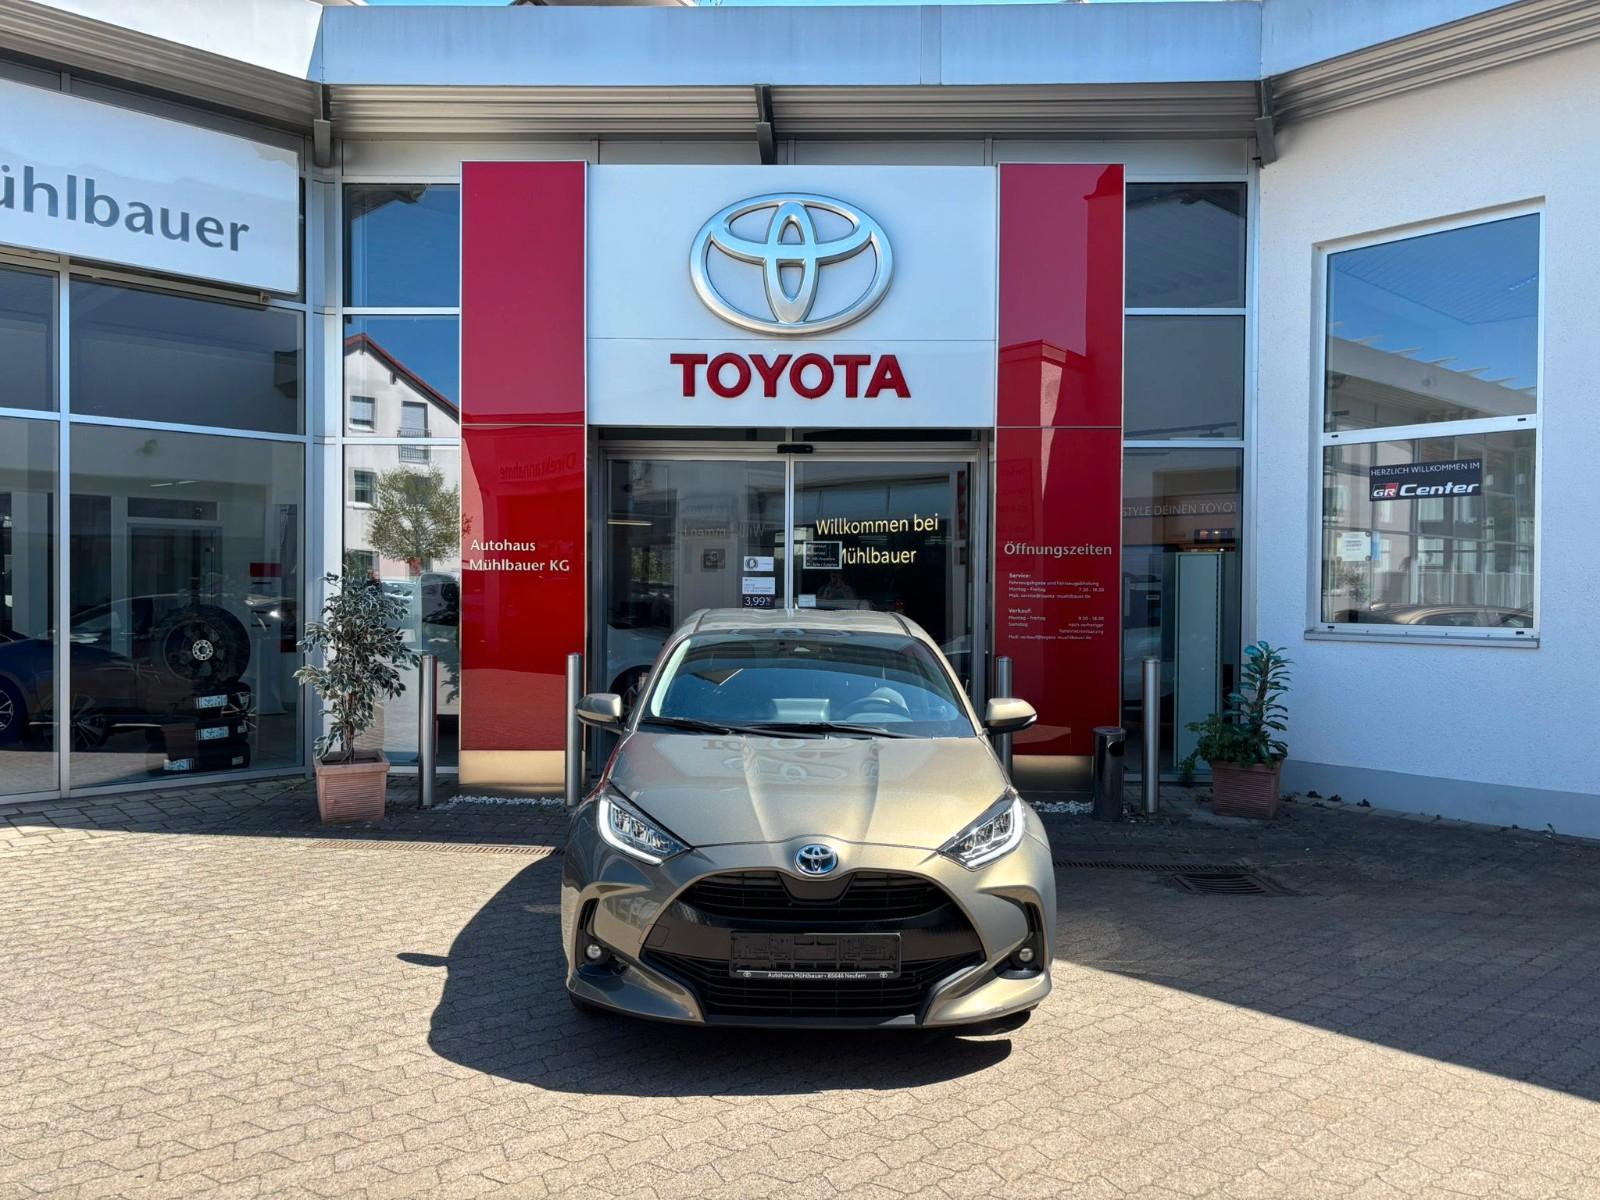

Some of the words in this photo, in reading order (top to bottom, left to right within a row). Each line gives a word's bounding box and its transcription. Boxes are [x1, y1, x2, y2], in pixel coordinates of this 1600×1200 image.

[670, 352, 912, 399] TOYOTA
[1370, 467, 1409, 476] HERZLICH
[1411, 463, 1468, 473] WILLKOMMEN
[1373, 488, 1395, 497] GR
[1400, 482, 1479, 496] Center
[1154, 503, 1197, 515] DEINEN
[816, 517, 909, 536] Willkommen
[914, 512, 939, 532] bei
[470, 539, 536, 552] Autohaus
[1003, 541, 1112, 558] Öffnungszeiten
[469, 559, 545, 571] Mühlbauer
[550, 559, 570, 572] KG
